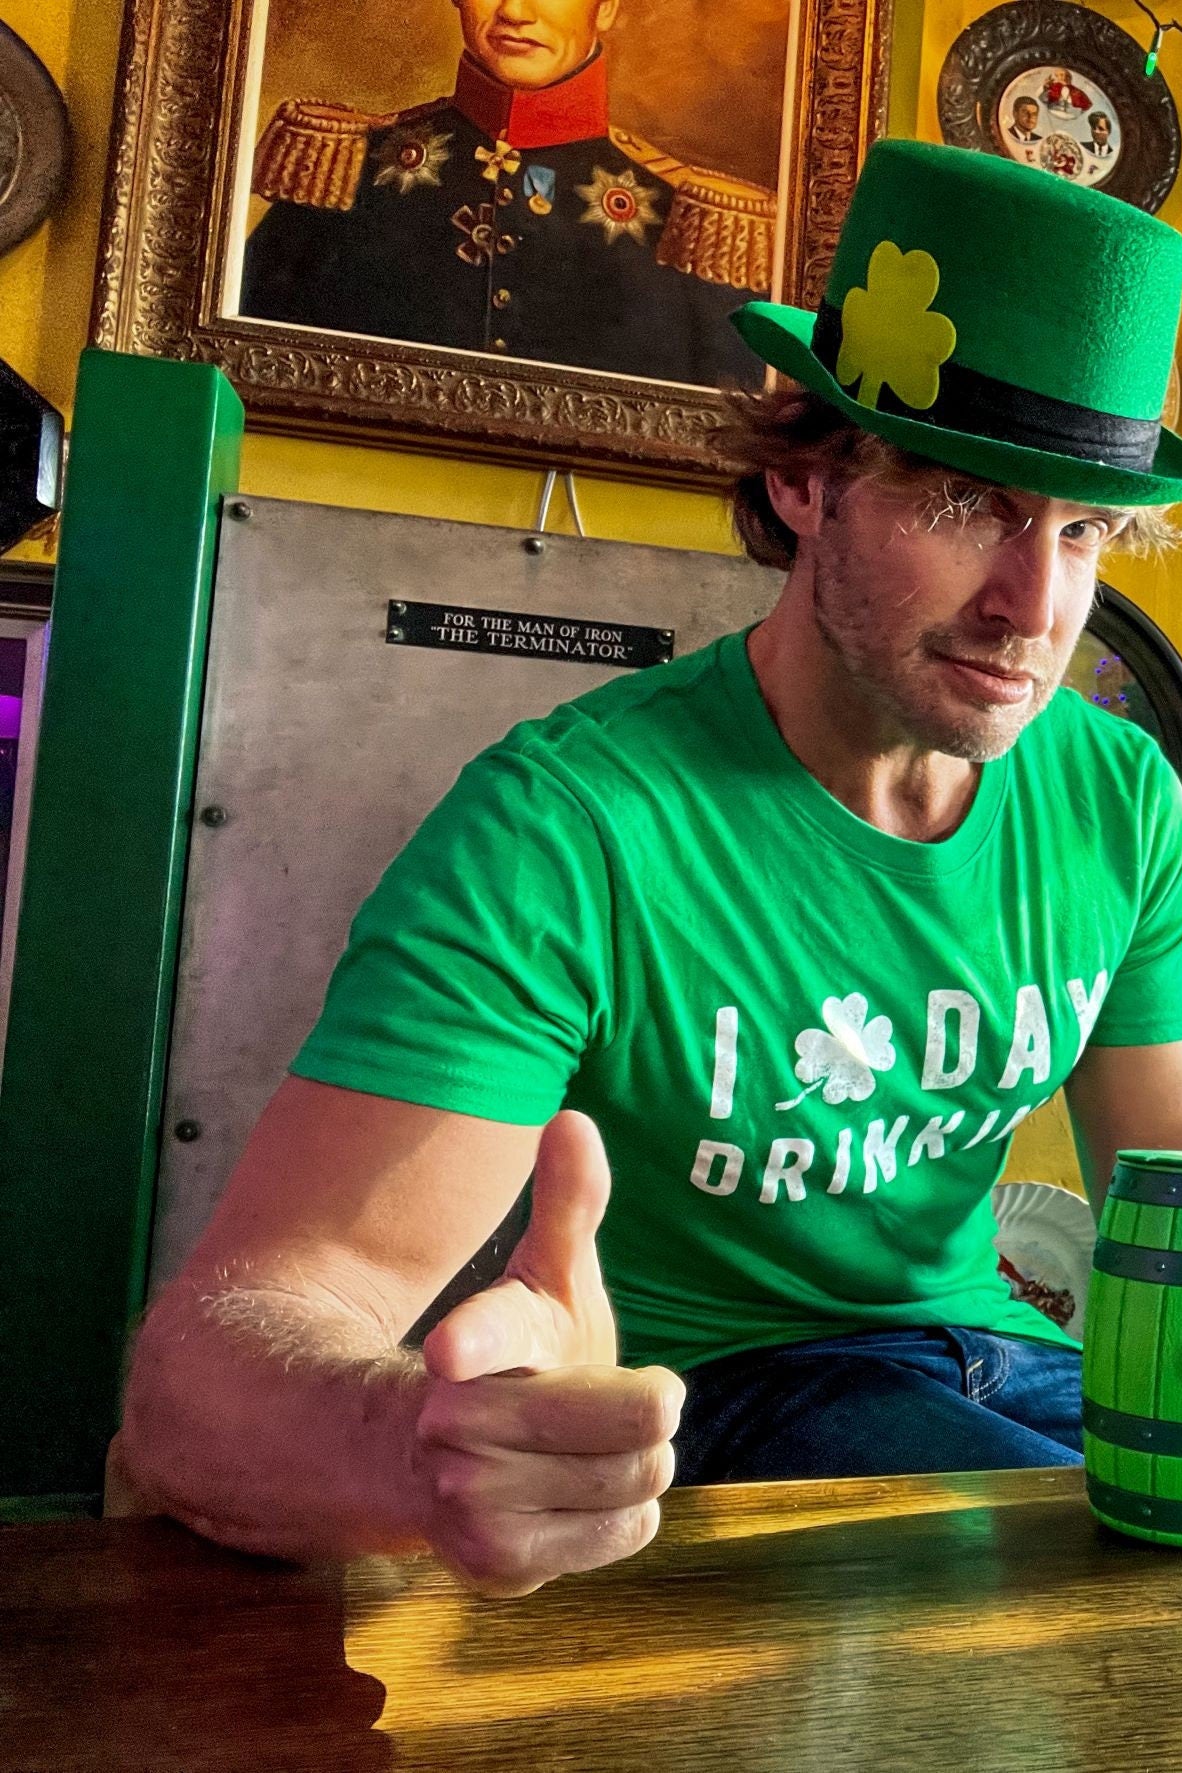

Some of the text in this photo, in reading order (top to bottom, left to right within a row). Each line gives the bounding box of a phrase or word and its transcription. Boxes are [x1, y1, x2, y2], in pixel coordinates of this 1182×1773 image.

[443, 612, 623, 643] FOR THE MAN OF IRON
[709, 969, 1109, 1119] I DAY
